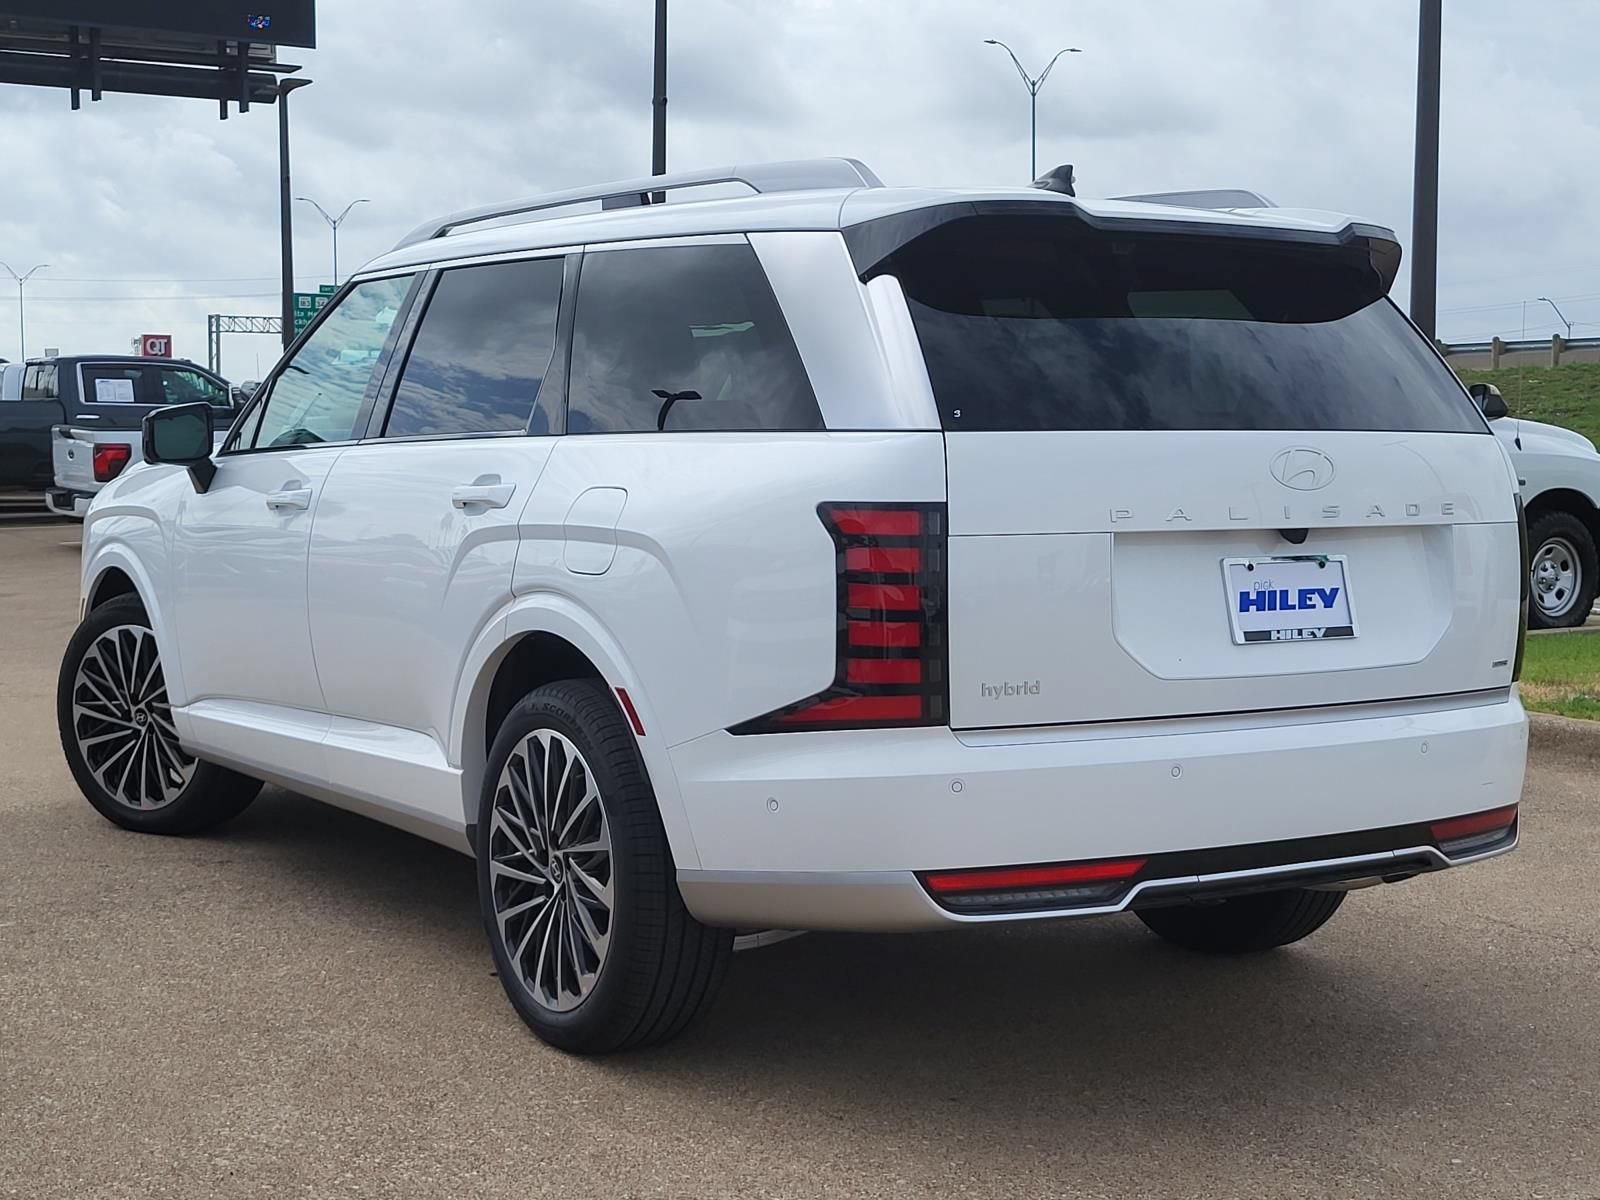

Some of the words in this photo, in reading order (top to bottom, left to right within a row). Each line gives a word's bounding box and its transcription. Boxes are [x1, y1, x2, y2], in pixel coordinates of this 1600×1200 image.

[146, 338, 168, 356] QT
[1110, 502, 1456, 523] PALISADE
[1238, 587, 1340, 612] HILEY
[1270, 628, 1326, 640] HILEY
[981, 680, 1041, 701] hybrid
